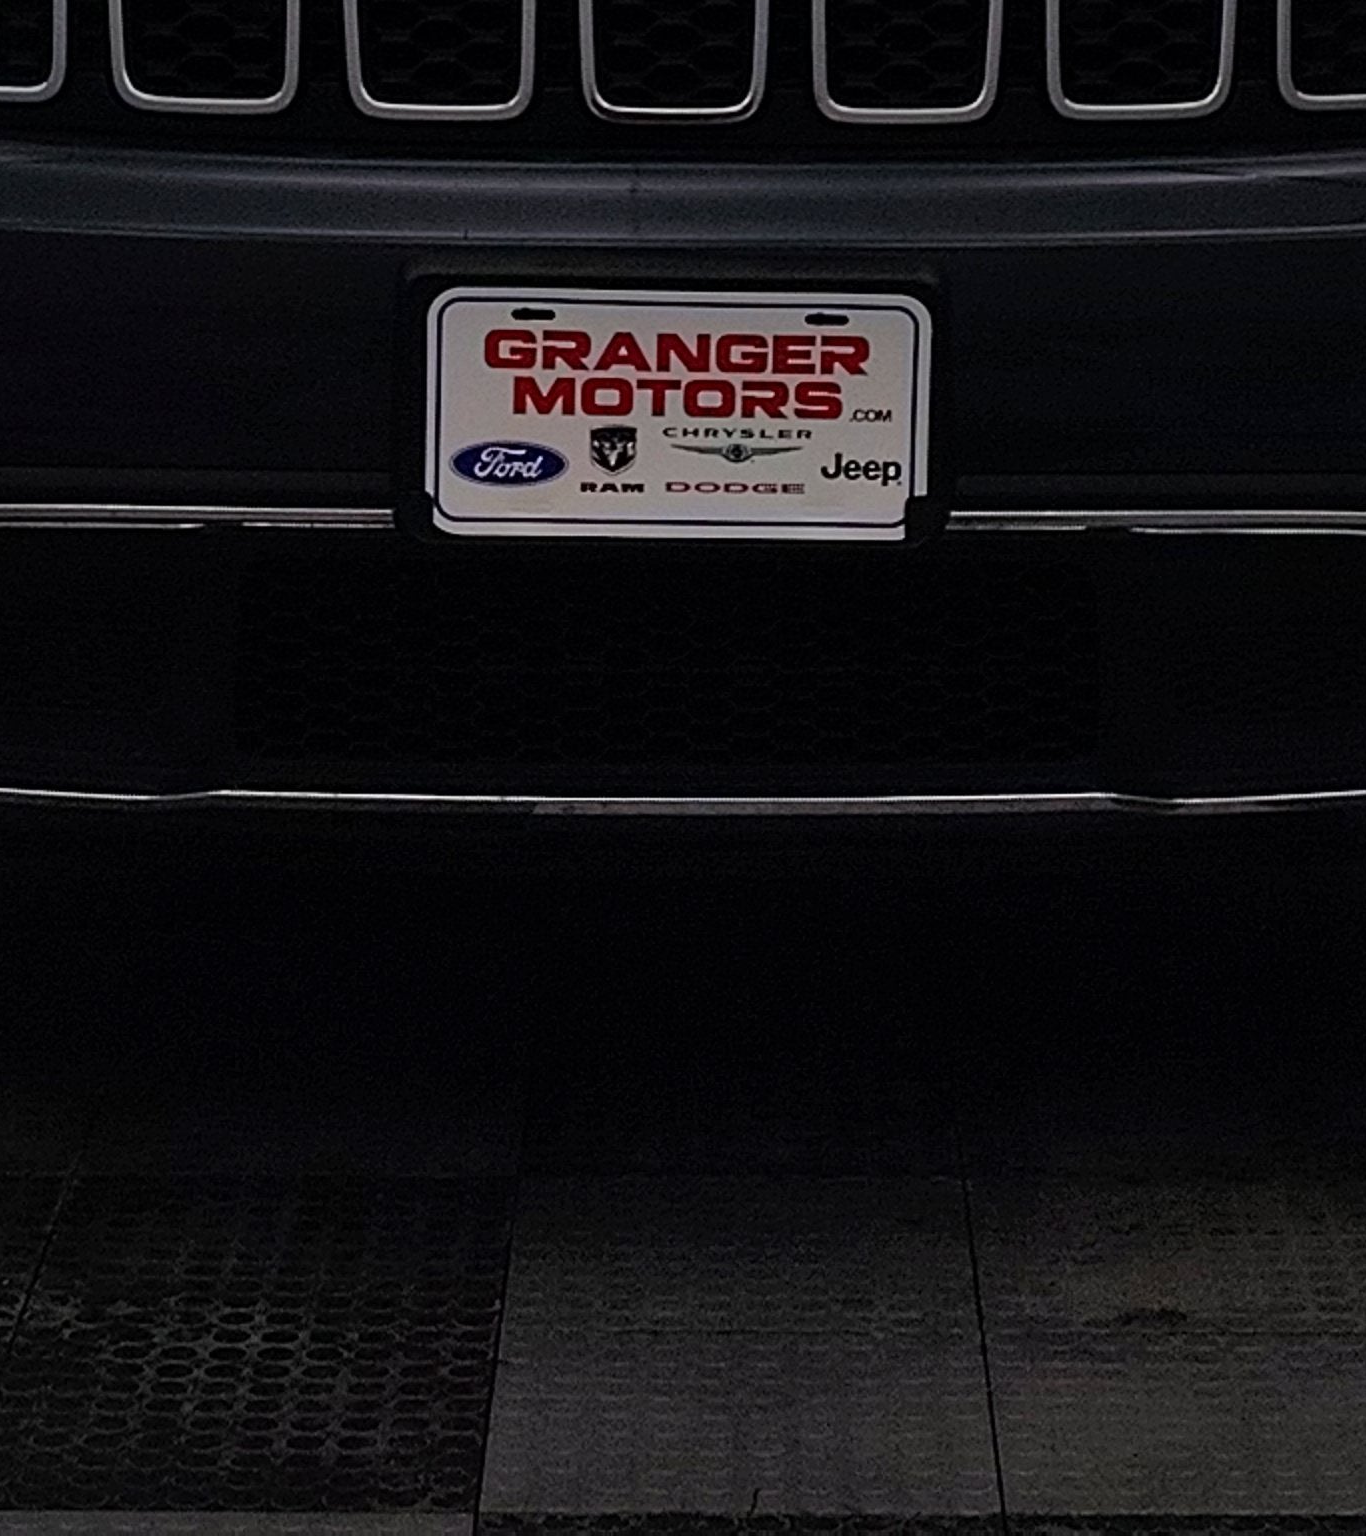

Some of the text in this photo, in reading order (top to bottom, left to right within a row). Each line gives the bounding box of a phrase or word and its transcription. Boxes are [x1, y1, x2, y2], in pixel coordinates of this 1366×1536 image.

[483, 329, 871, 375] GRANGER
[512, 376, 892, 423] MOTORS .COM
[662, 427, 813, 440] CHRYSLER
[474, 446, 544, 478] Ford
[821, 452, 902, 486] Jeep
[580, 482, 645, 493] RAM
[665, 482, 806, 495] DODGE
